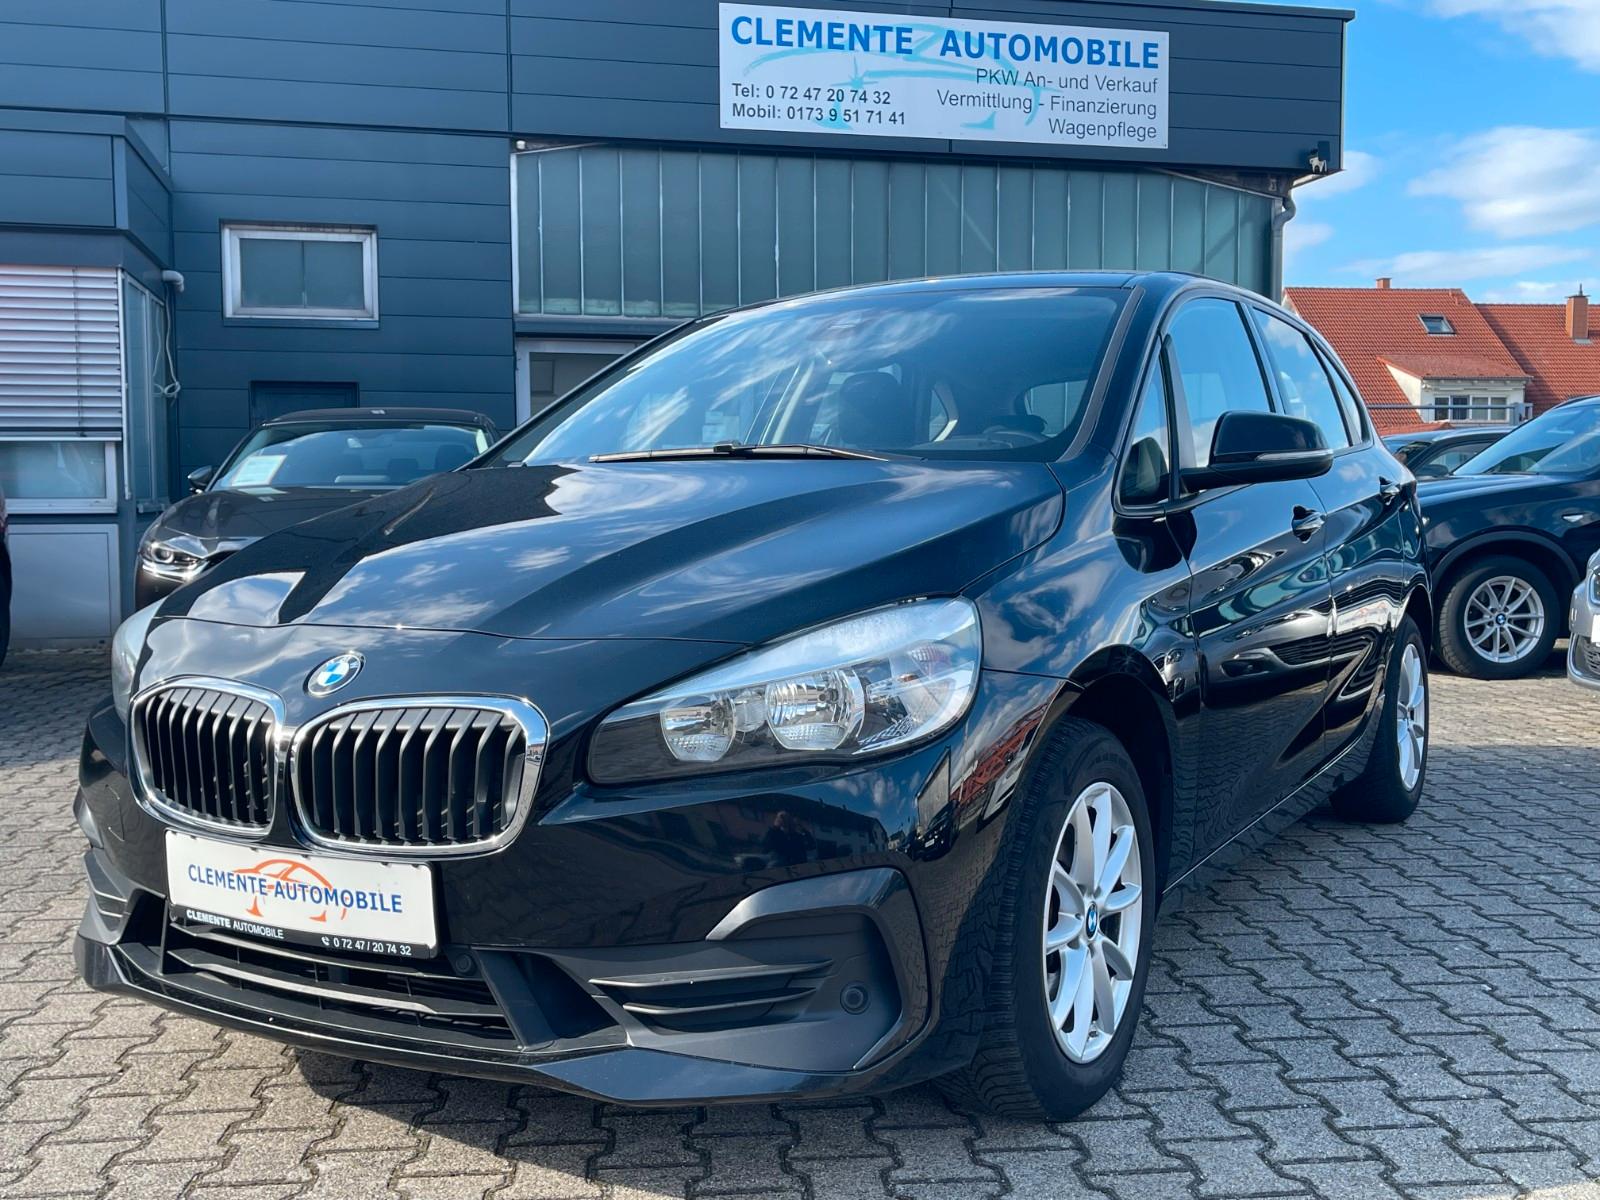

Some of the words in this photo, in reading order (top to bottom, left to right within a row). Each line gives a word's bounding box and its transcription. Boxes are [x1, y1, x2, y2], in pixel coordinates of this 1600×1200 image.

[730, 15, 914, 55] CLEMENTE
[939, 29, 1159, 69] AUTOMOBILE
[976, 68, 1019, 86] PKW
[1024, 71, 1053, 88] An-
[1058, 75, 1089, 90] und
[1095, 75, 1158, 93] Verkauf
[732, 83, 760, 98] Tel:
[766, 85, 775, 99] 0
[780, 86, 798, 100] 72
[803, 87, 821, 101] 47
[827, 88, 845, 102] 20
[850, 90, 868, 103] 74
[873, 91, 891, 105] 32
[937, 89, 1033, 114] Vermittlung
[1050, 96, 1157, 120] Finanzierung
[732, 103, 781, 119] Mobil:
[787, 106, 824, 121] 0173
[829, 108, 838, 122] 9
[843, 109, 859, 123] 51
[866, 110, 882, 124] 71
[888, 111, 905, 125] 41
[1049, 118, 1157, 142] Wagenpflege
[188, 864, 267, 896] CLEMENTE
[274, 882, 403, 913] AUTOMOBILE
[186, 909, 232, 928] CLEMENTE
[233, 920, 284, 939] AUTOMOBILE
[333, 937, 340, 948] 0
[341, 938, 353, 949] 72
[355, 940, 365, 950] 47
[372, 942, 384, 953] 20
[386, 943, 397, 954] 74
[399, 945, 412, 956] 32
